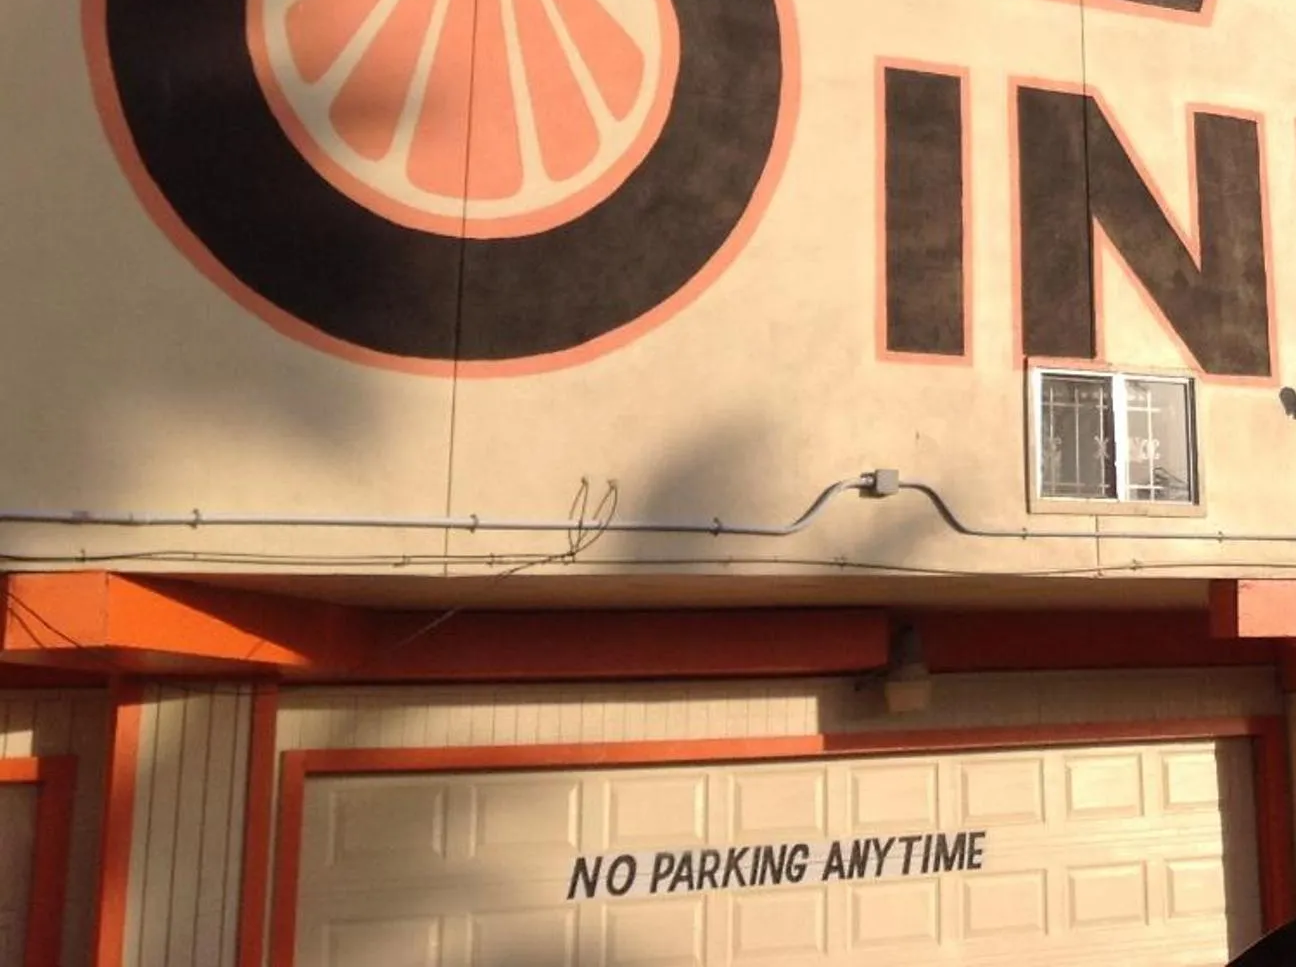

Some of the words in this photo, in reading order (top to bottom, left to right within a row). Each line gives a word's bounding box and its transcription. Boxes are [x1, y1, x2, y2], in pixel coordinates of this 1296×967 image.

[567, 854, 637, 899] NO
[649, 843, 809, 893] PARKING
[821, 831, 986, 881] ANYTIME
